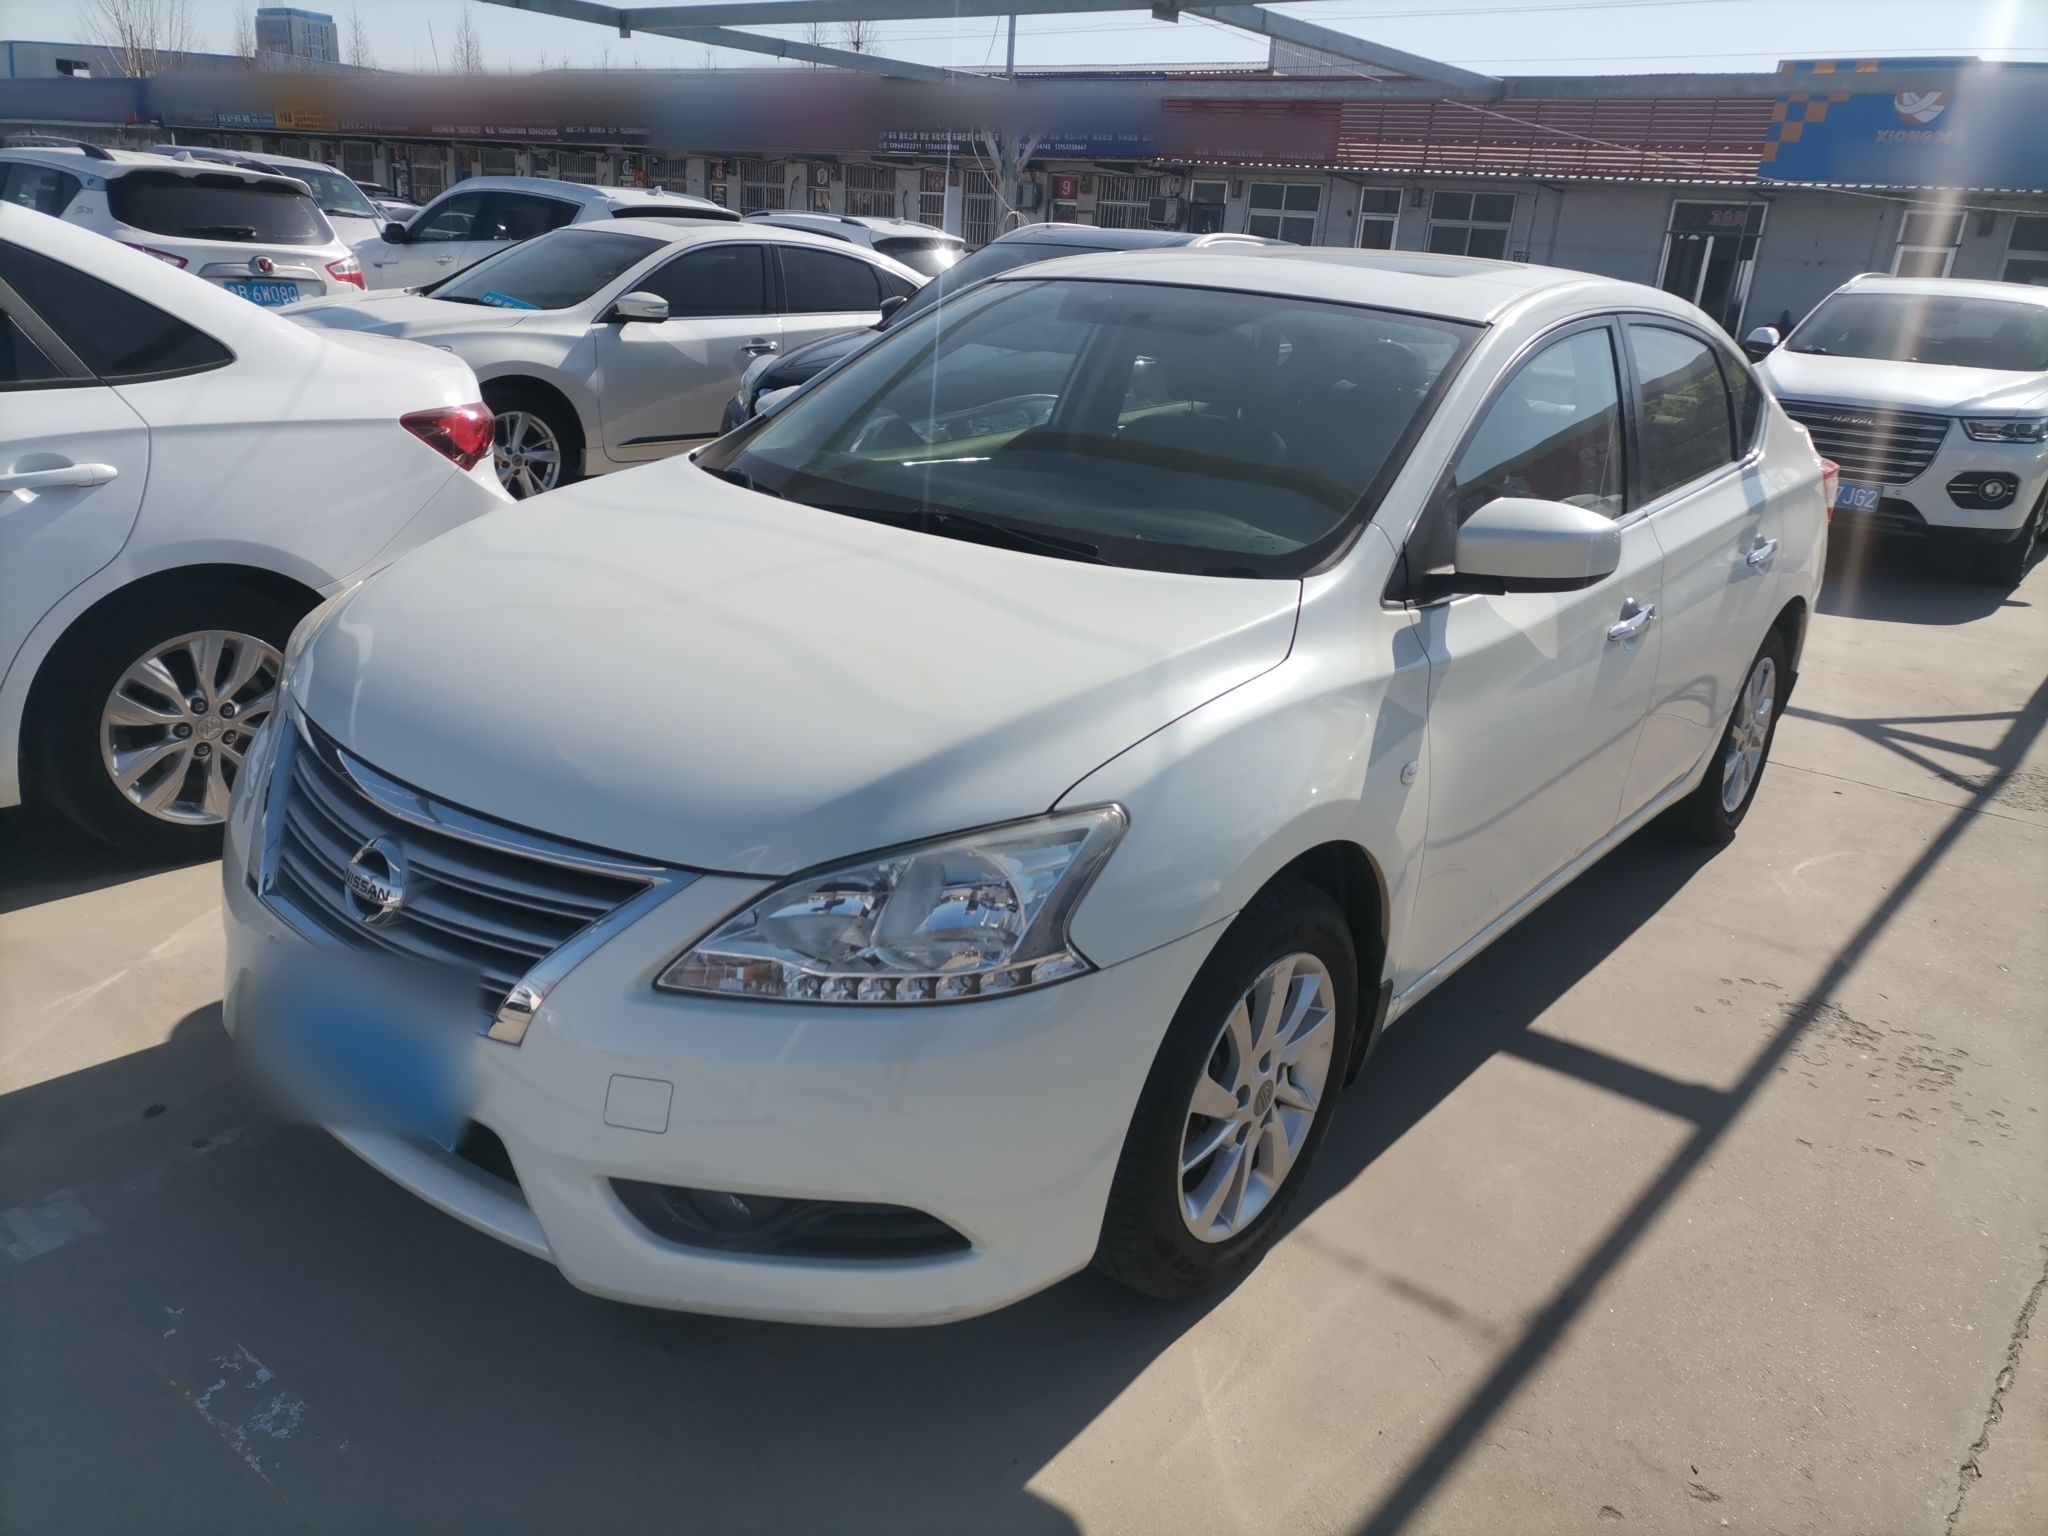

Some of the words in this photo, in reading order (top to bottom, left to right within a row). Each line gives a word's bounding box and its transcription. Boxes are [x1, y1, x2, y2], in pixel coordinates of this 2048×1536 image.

[1061, 179, 1071, 196] 9
[1831, 414, 1873, 425] HAVAL
[344, 867, 391, 902] NISSAN
